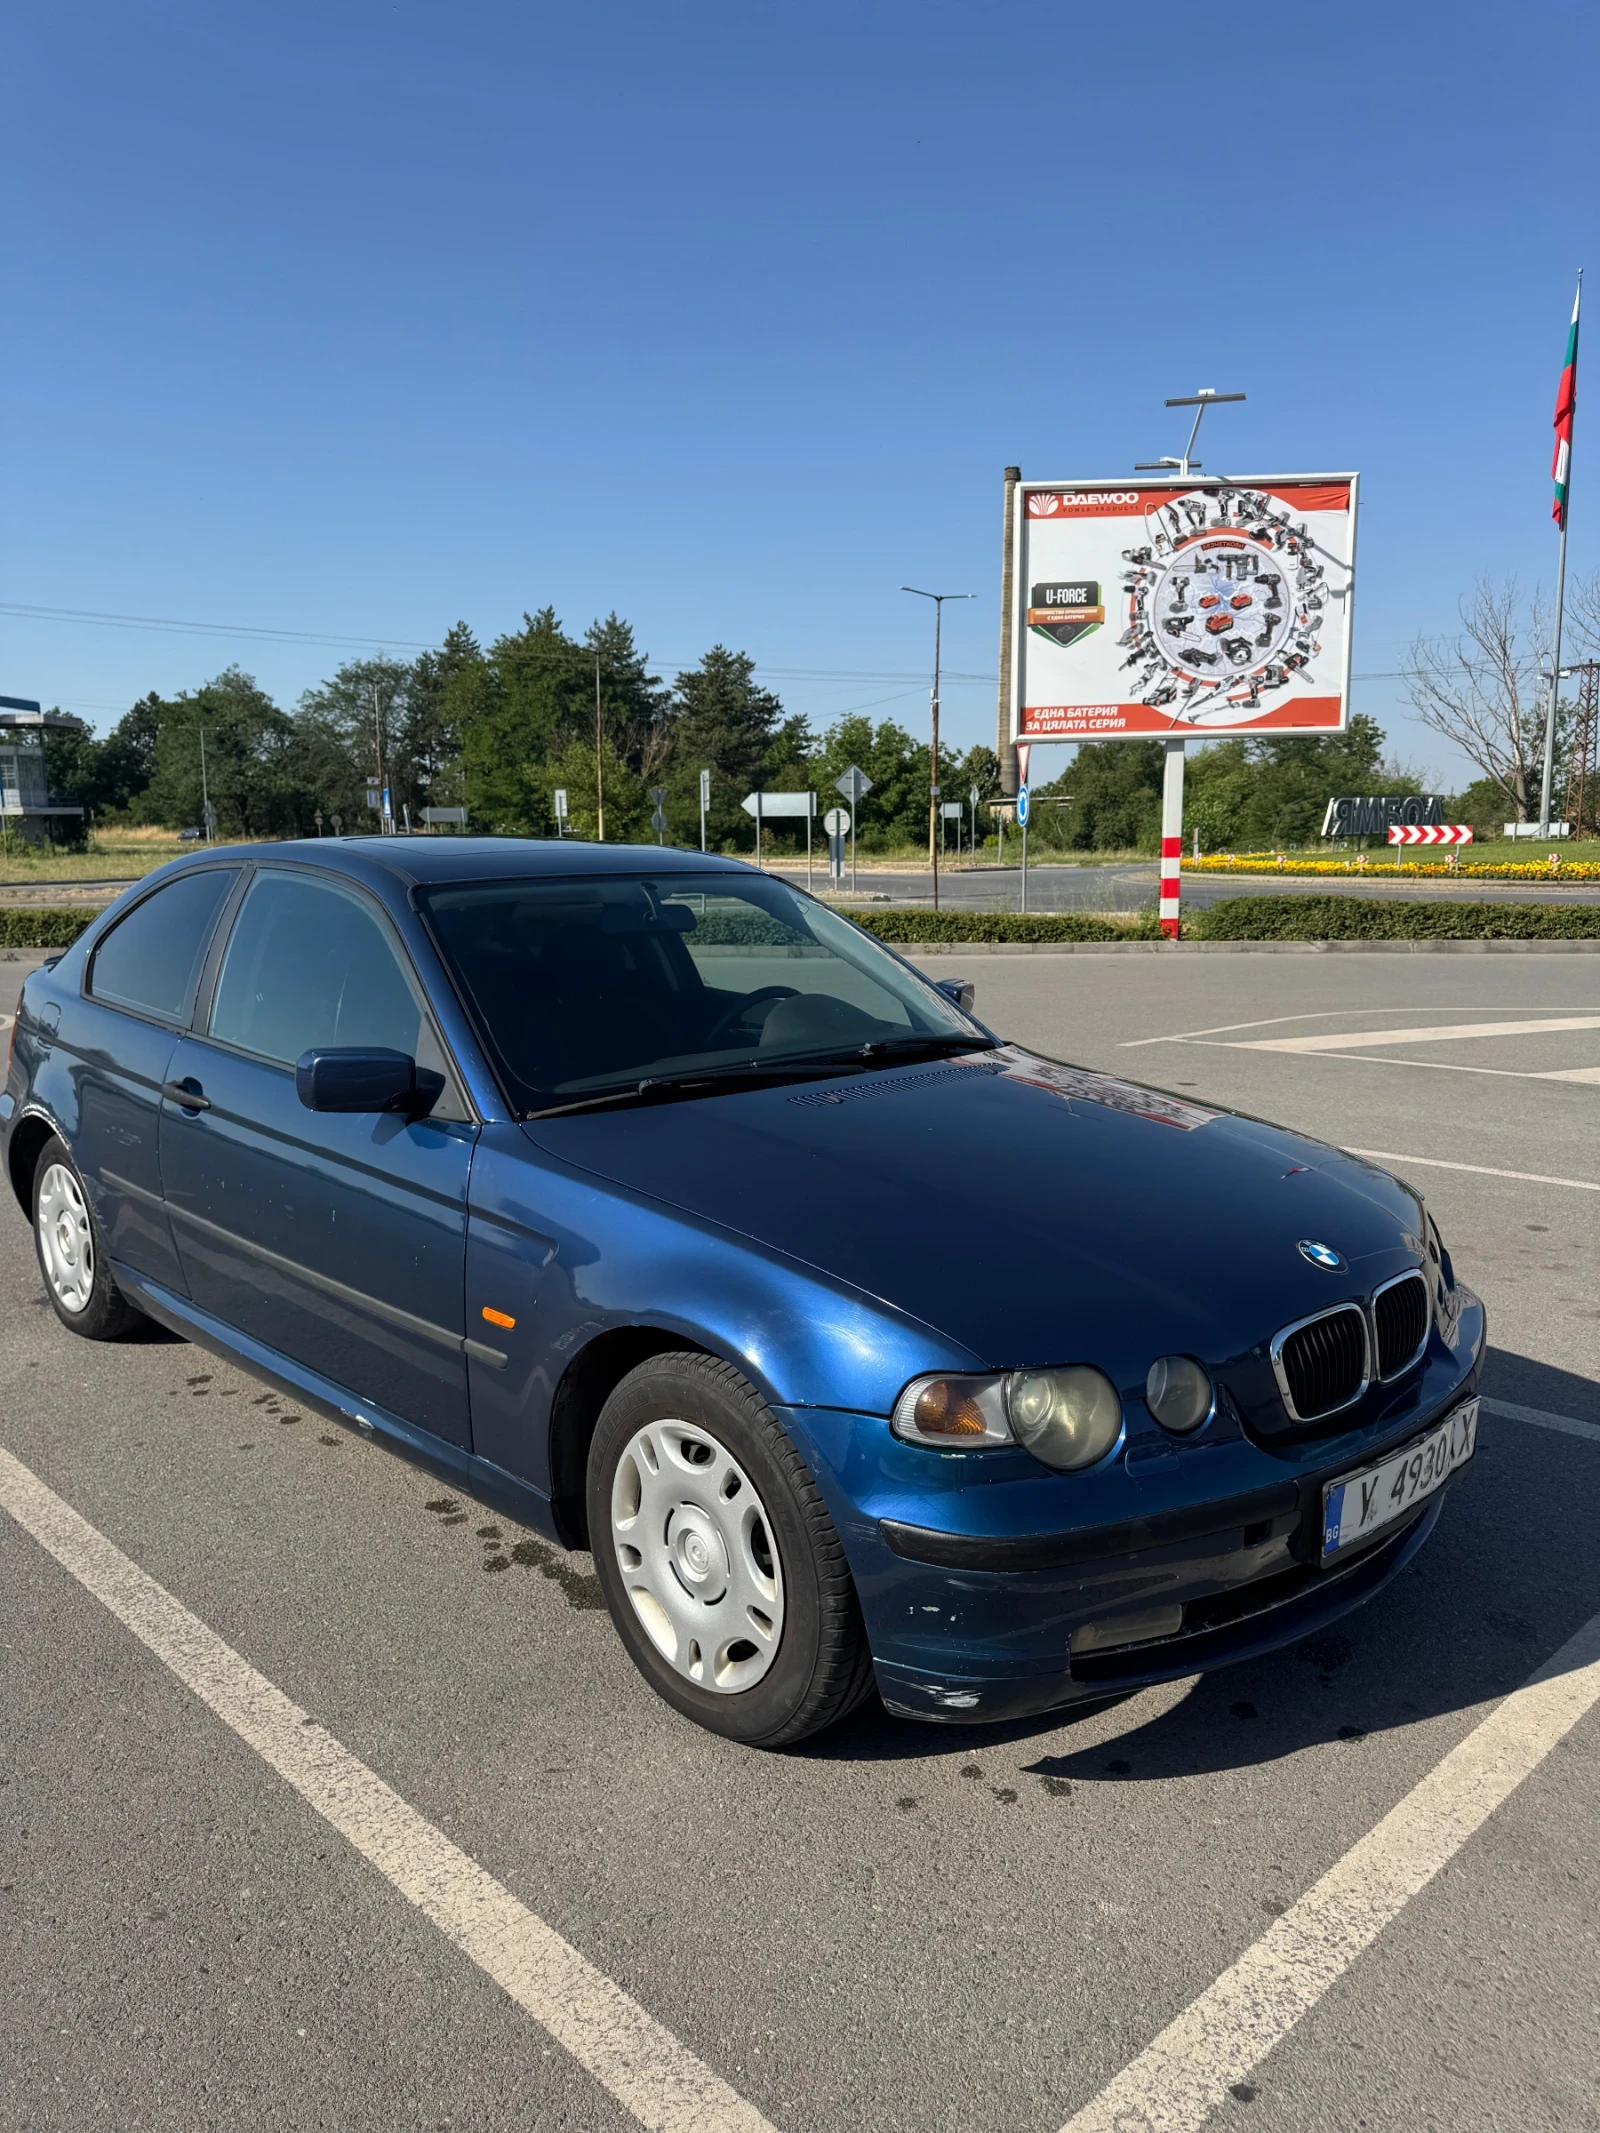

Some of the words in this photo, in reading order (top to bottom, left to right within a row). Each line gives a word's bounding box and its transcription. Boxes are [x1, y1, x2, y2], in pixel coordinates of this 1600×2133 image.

[1063, 492, 1139, 506] DAEWOO
[1046, 588, 1087, 604] U-FORCE
[1034, 708, 1065, 720] ЕДНА
[1067, 706, 1118, 718] БАТЕРИЯ
[1025, 721, 1040, 731] ЗА
[1042, 719, 1087, 732] ЦЯЛАТА
[1089, 718, 1126, 729] СЕРИЯ
[1390, 1432, 1448, 1506] 4930
[1326, 1524, 1340, 1544] BG
